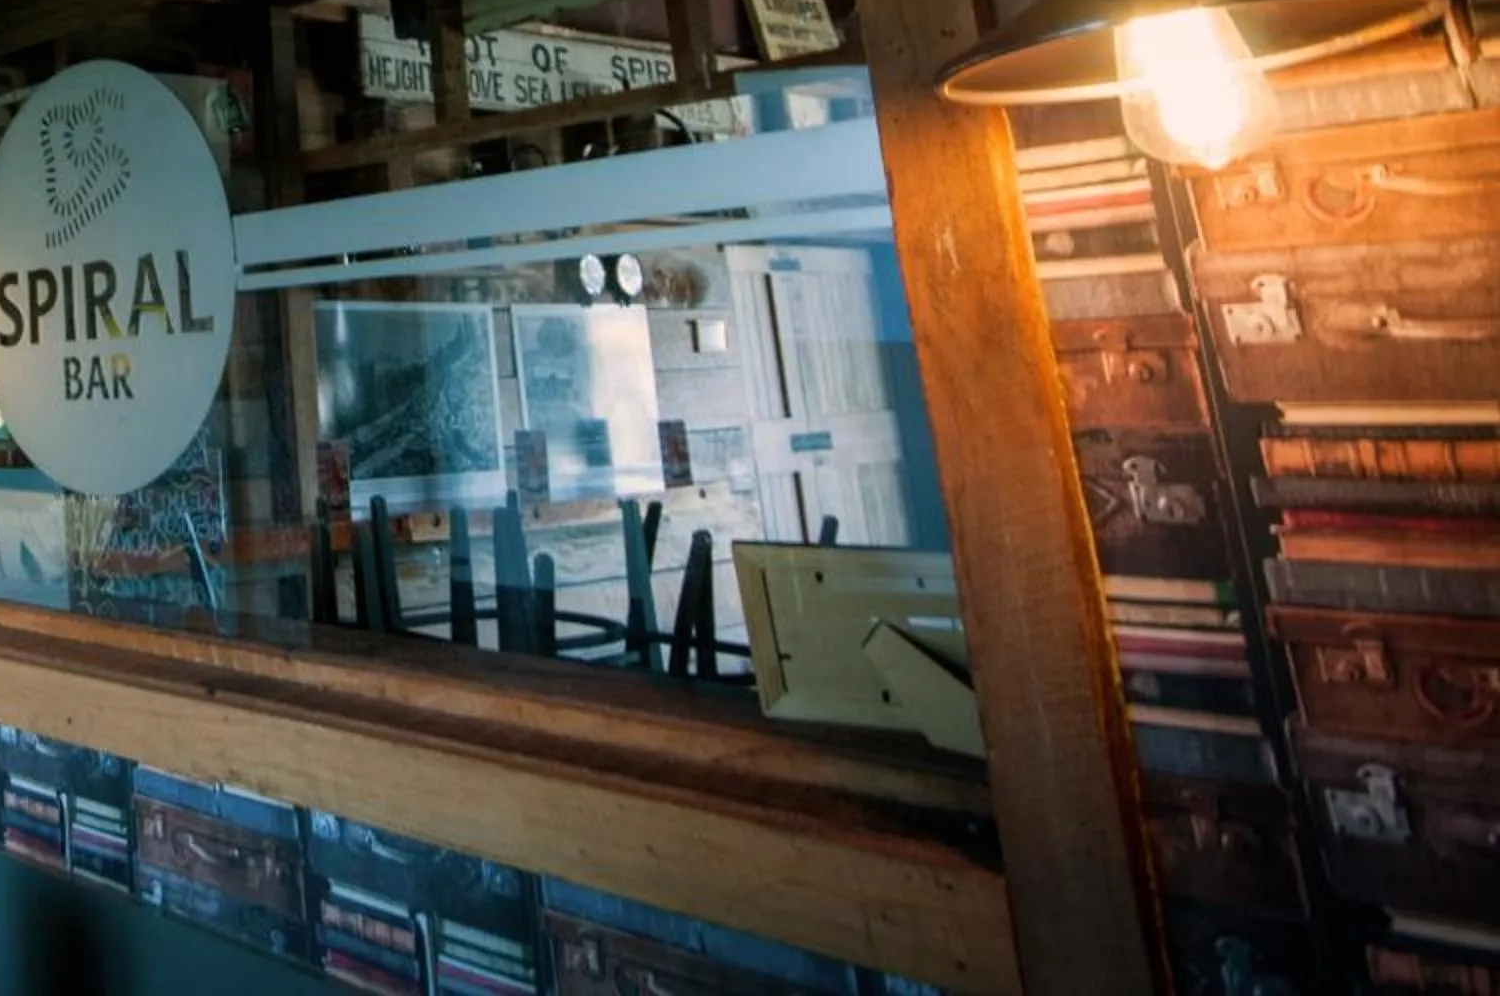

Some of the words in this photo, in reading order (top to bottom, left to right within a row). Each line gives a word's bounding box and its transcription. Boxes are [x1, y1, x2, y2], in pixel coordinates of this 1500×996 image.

[531, 43, 568, 74] OF
[611, 55, 673, 84] SPIR
[514, 74, 551, 104] SEA
[63, 353, 134, 401] BAR
